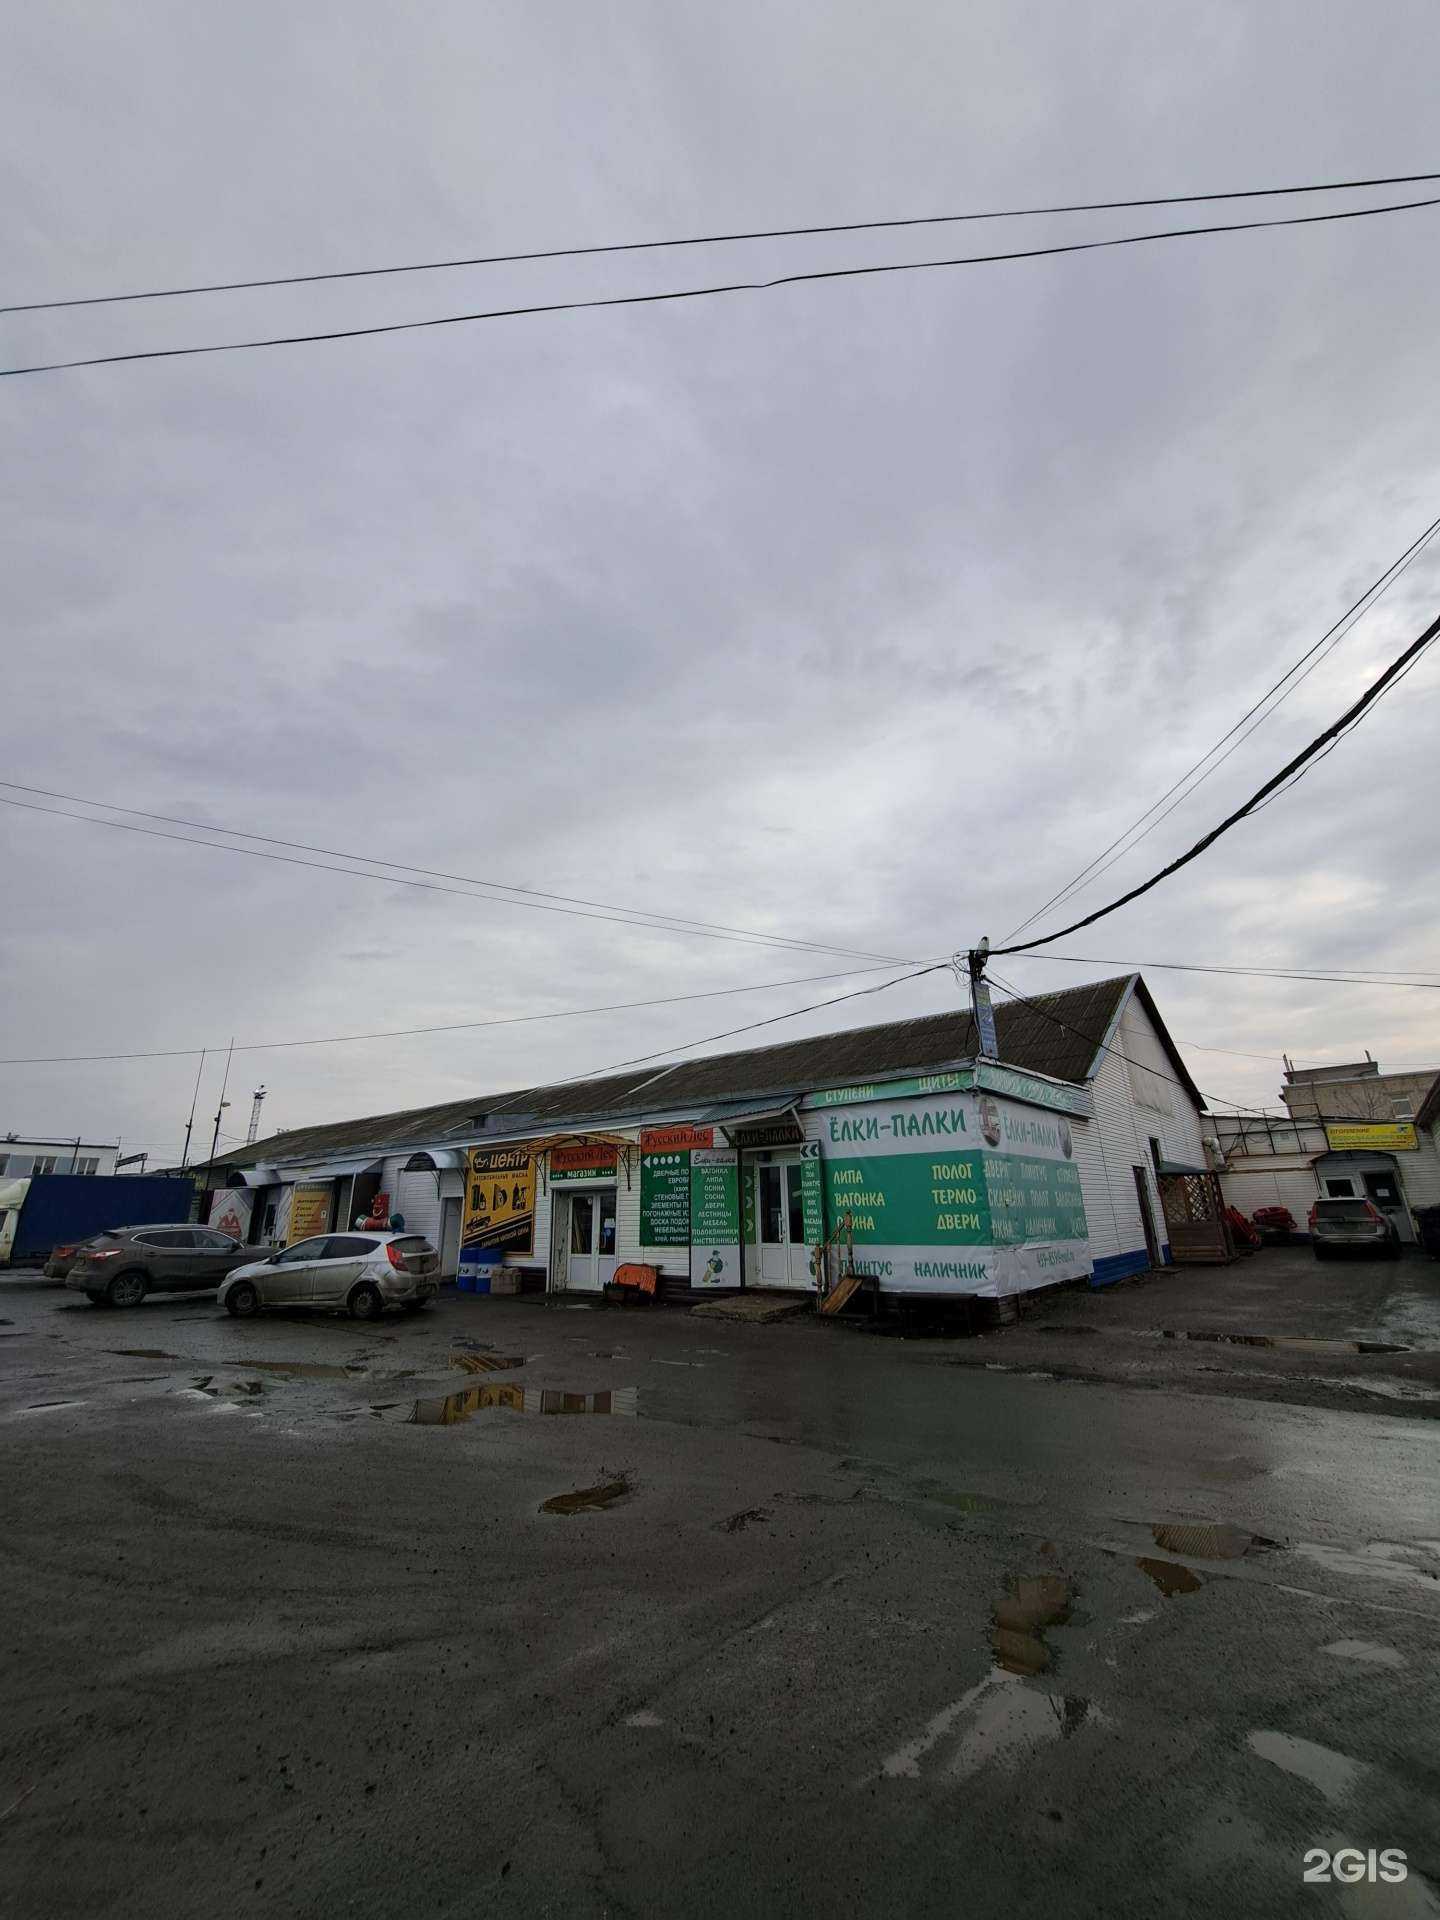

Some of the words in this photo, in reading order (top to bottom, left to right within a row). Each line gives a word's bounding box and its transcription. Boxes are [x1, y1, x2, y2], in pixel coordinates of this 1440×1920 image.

[829, 1109, 967, 1143] ЁЛКИ-ПАЛКИ
[1003, 1111, 1058, 1149] ЁЛКИ-ПАЛКИ
[681, 1167, 689, 1176] ПО
[833, 1169, 864, 1184] ЛИПА
[834, 1192, 886, 1207] ВАГОНКА
[931, 1189, 977, 1205] ТЕРМО
[836, 1215, 875, 1231] ОИНА
[936, 1213, 981, 1231] ДВЕРИ
[840, 1260, 893, 1276] ПИНТУС
[914, 1262, 988, 1279] НАЛИЧНИК
